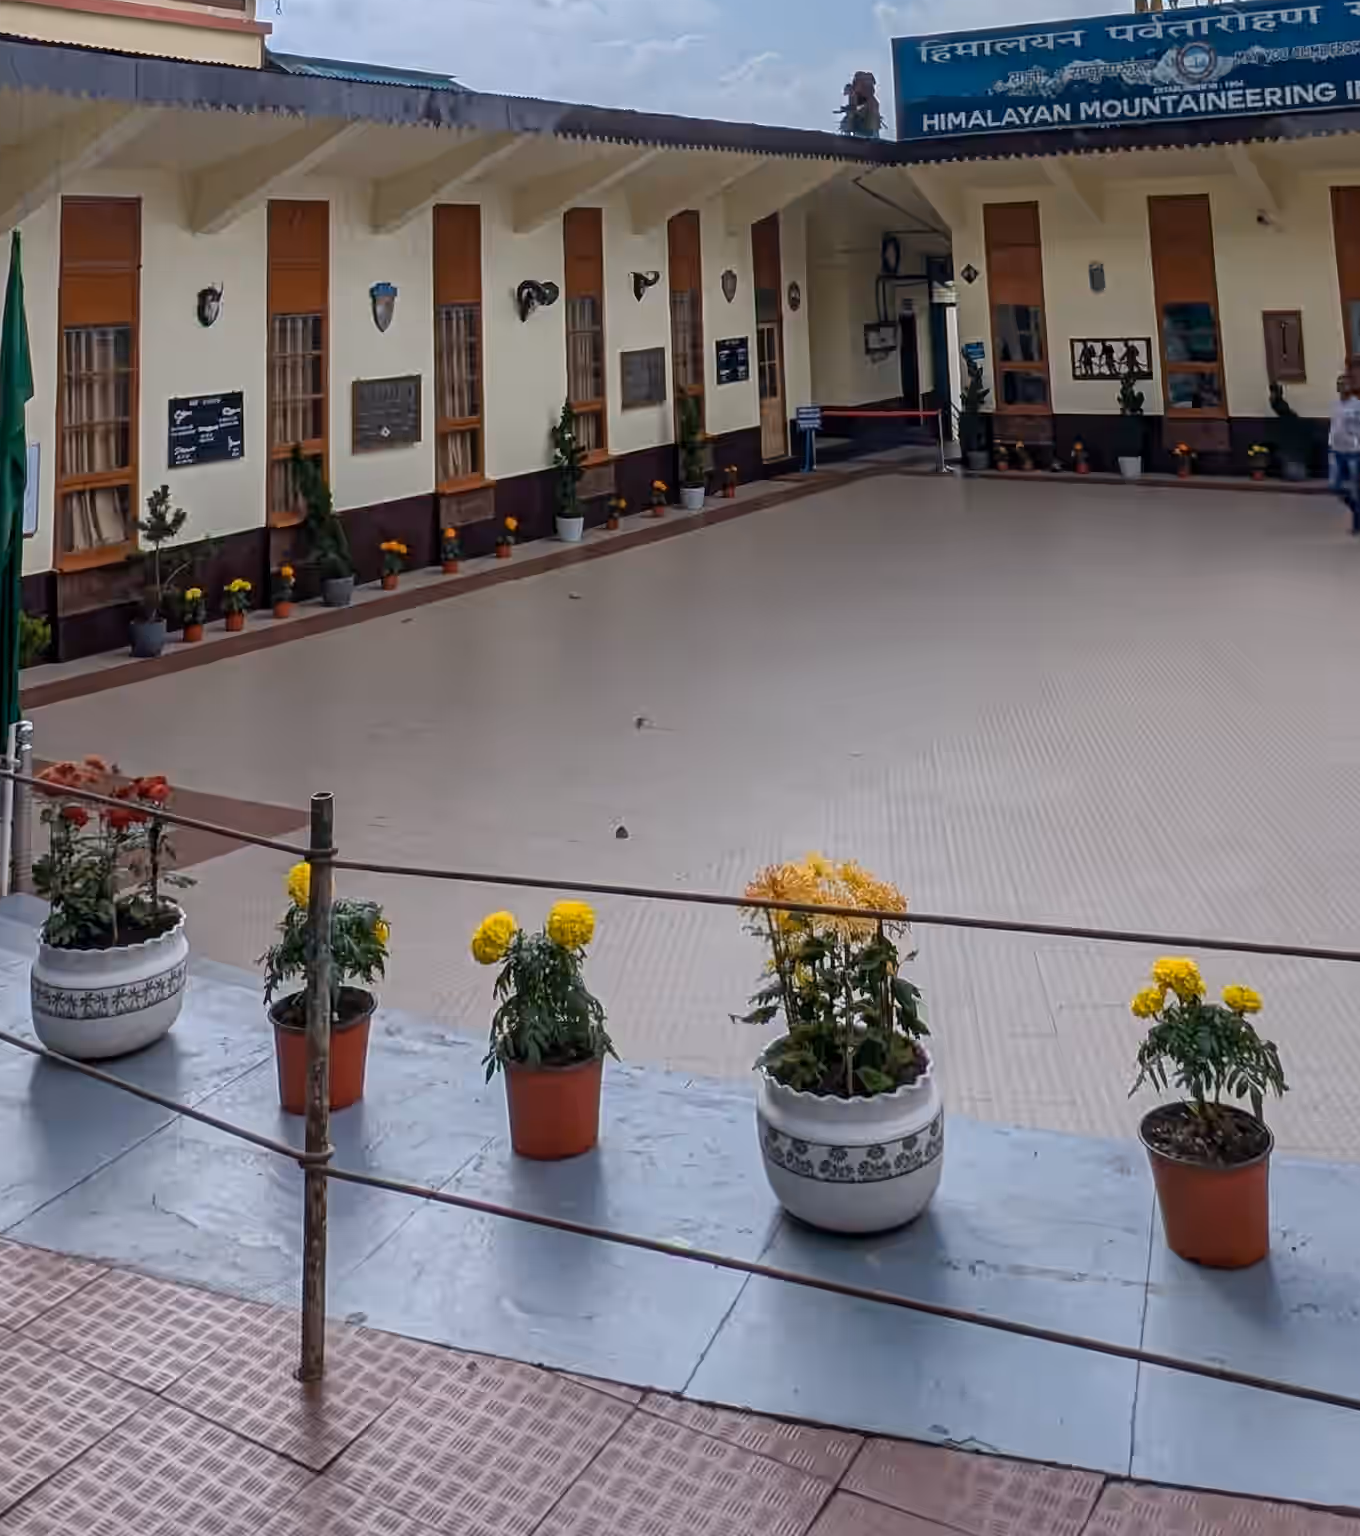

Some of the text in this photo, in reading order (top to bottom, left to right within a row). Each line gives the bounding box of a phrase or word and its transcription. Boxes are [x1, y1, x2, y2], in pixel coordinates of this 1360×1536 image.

[916, 30, 1085, 63] हिमालयन
[1105, 5, 1322, 42] पर्वतारोहण
[922, 103, 1071, 132] HIMALAYAN
[1080, 81, 1337, 120] MOUNTAINEERING
